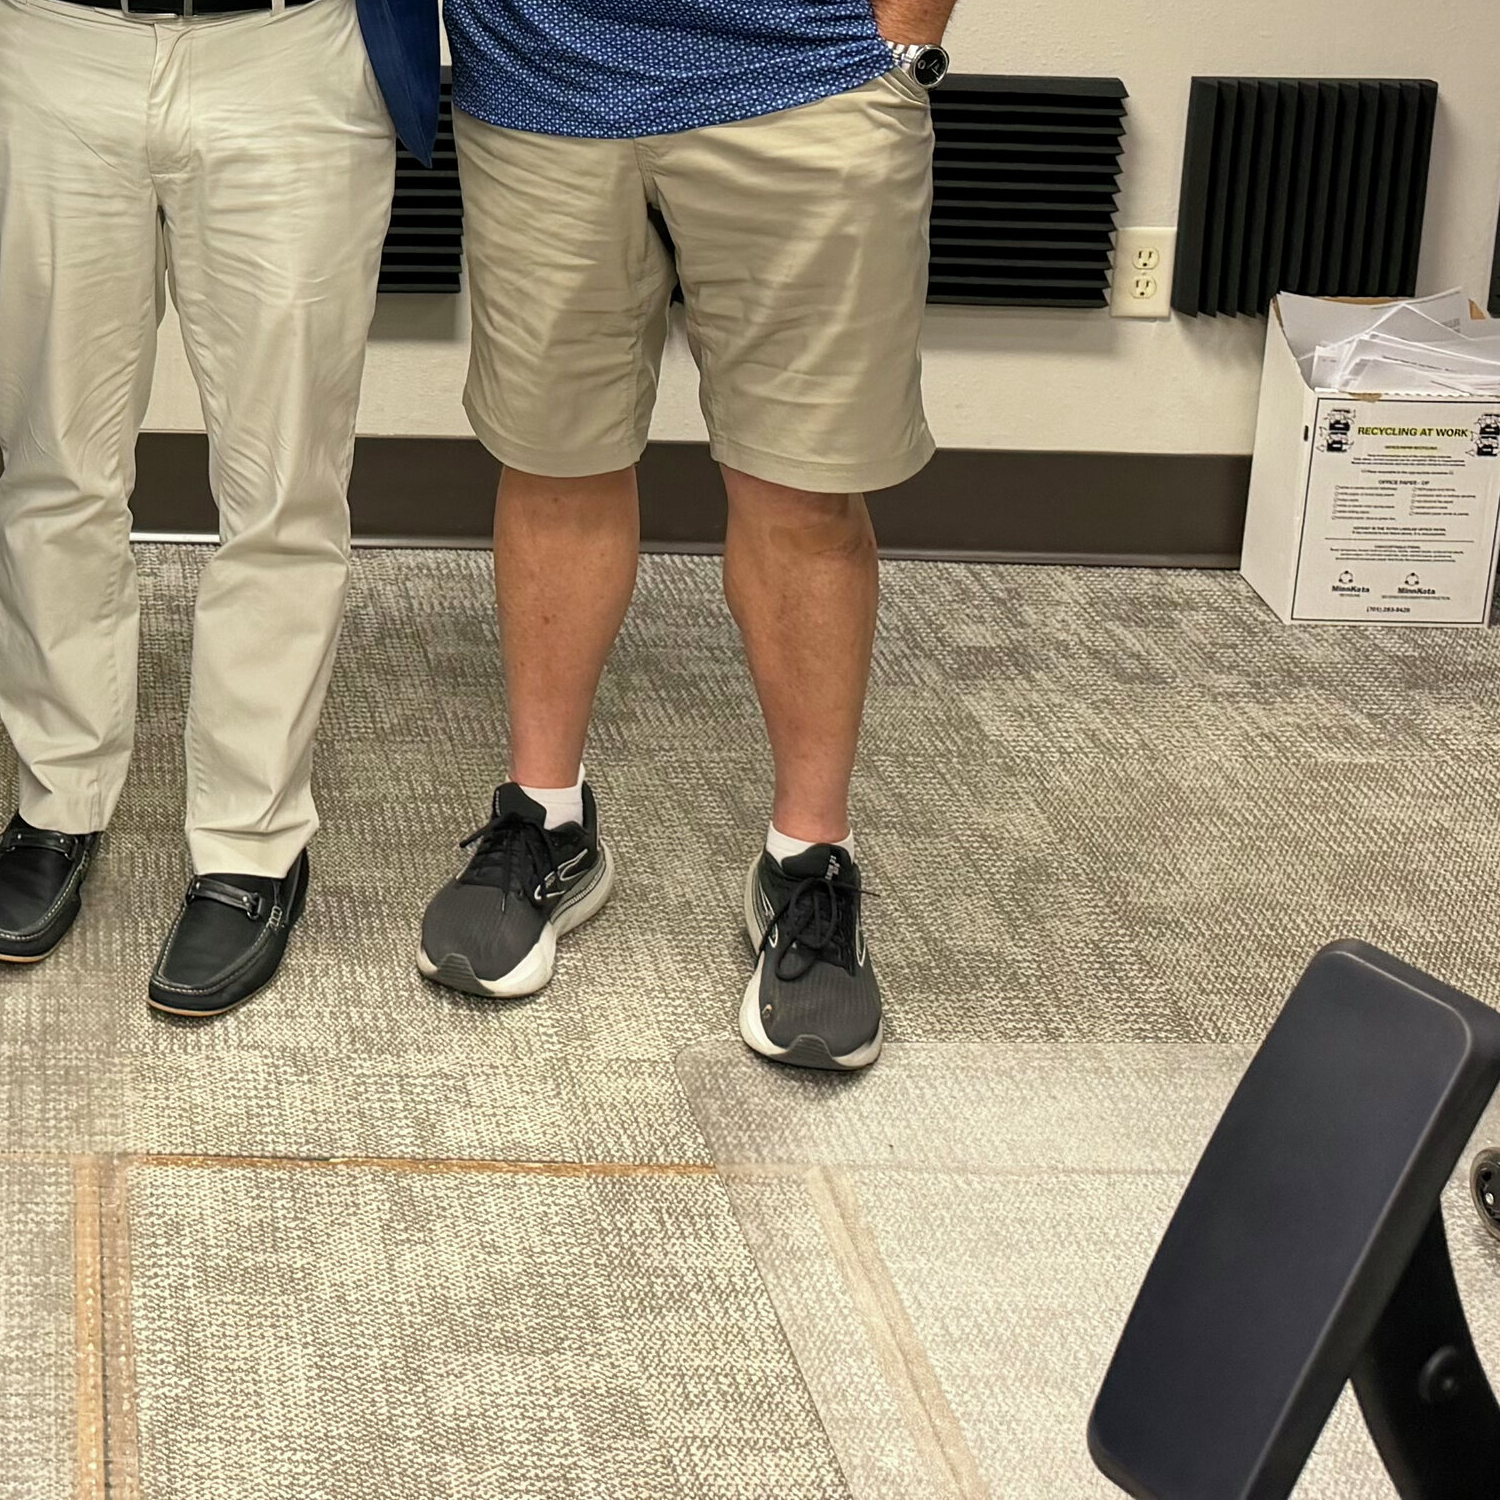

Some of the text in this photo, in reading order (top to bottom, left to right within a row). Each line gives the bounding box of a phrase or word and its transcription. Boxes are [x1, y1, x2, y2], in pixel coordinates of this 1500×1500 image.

[1357, 426, 1469, 438] RECYCLING AT WORK
[1332, 585, 1370, 593] MinnKota
[1397, 587, 1436, 595] MinnKota
